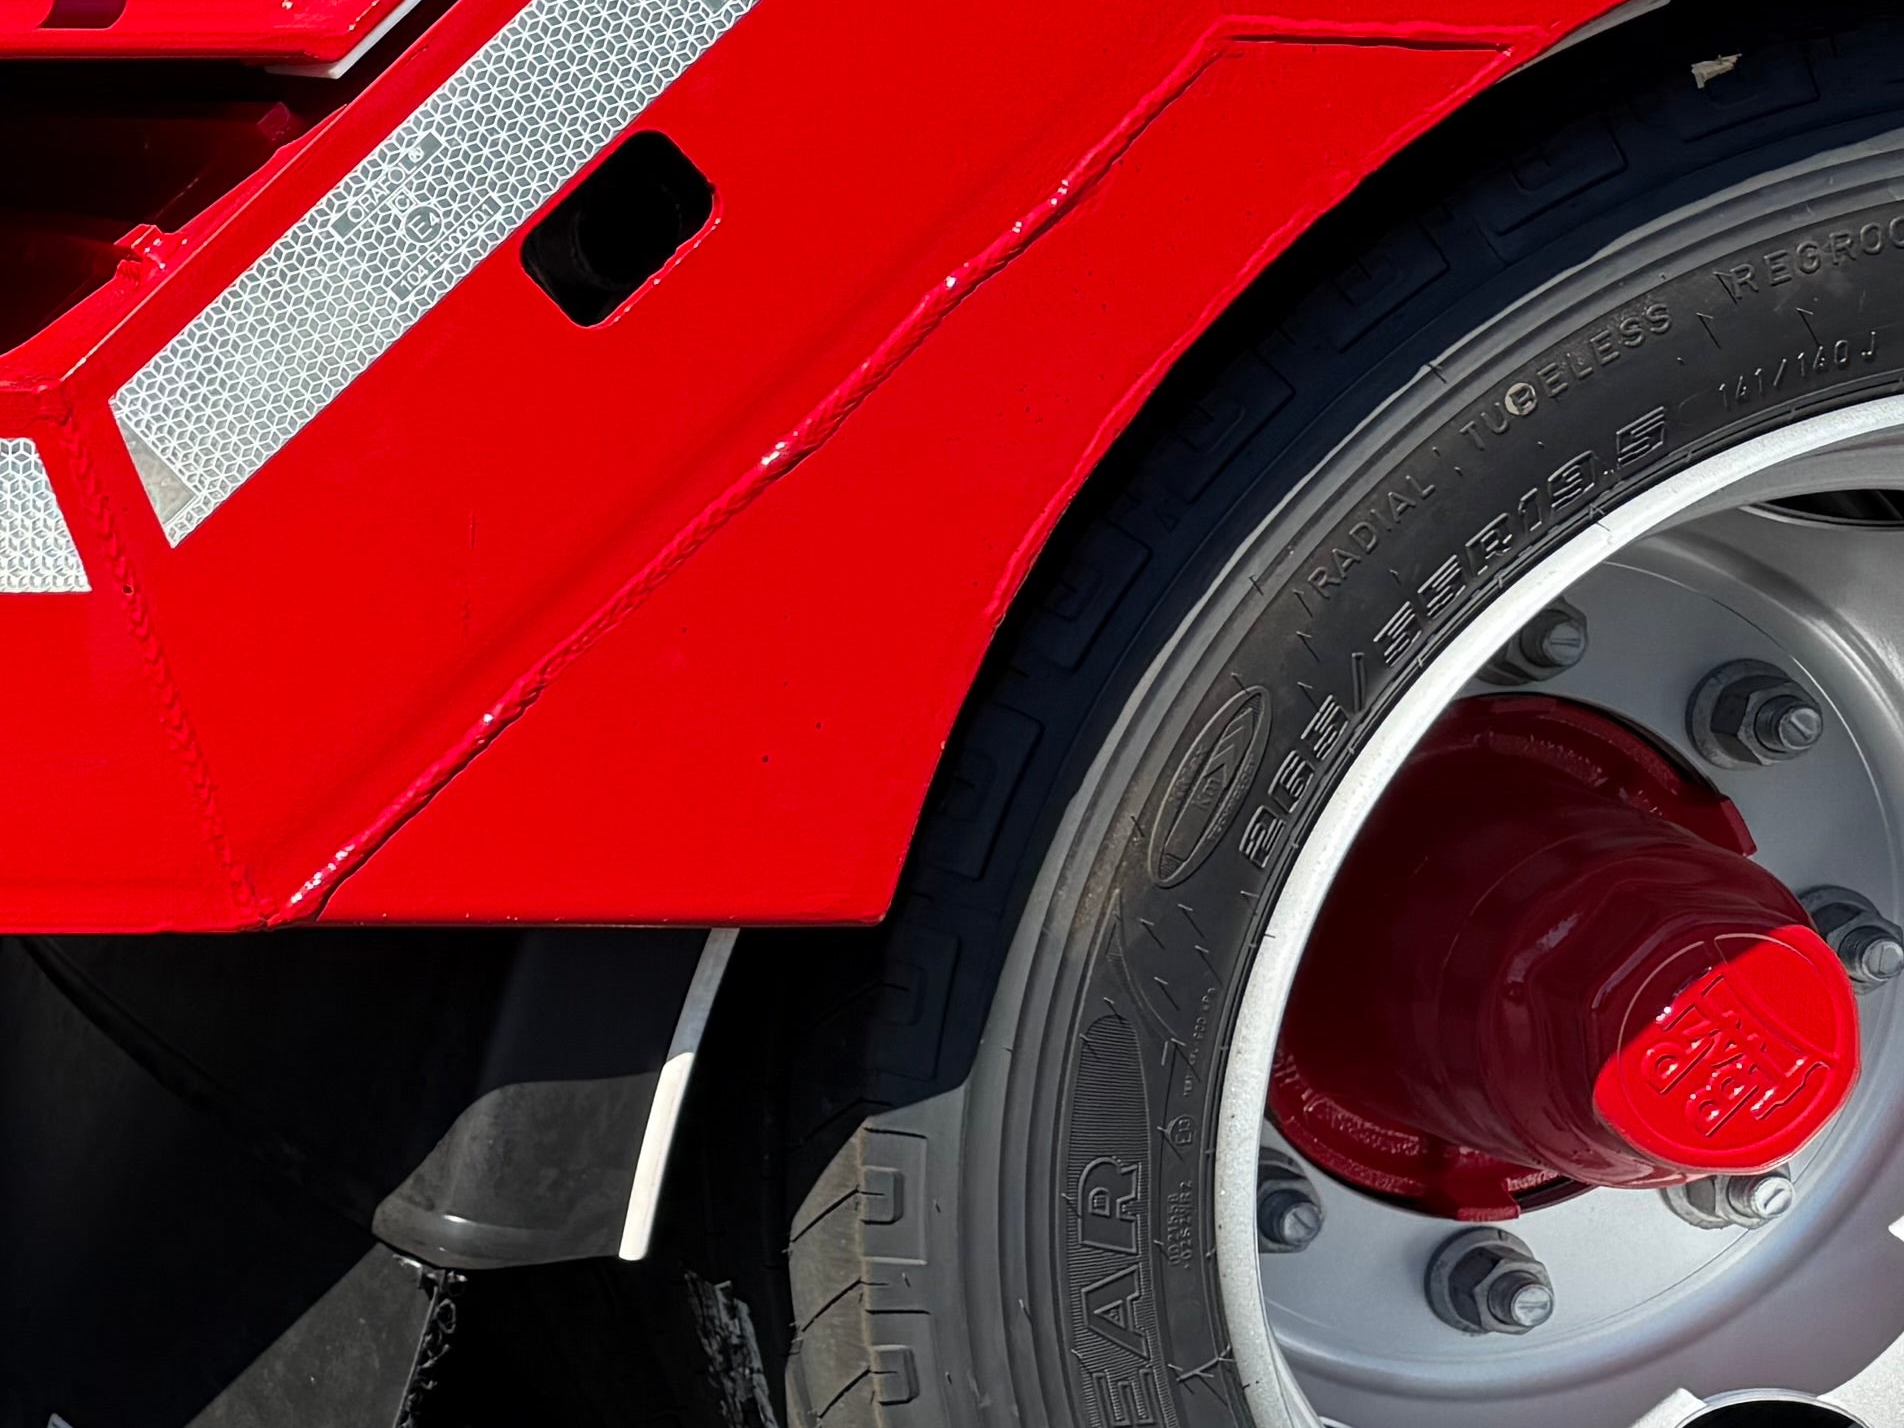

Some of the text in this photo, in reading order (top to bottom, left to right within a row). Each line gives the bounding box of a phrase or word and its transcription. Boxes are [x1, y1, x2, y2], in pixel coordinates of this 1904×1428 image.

[399, 203, 495, 292] 104 R-000001
[1310, 474, 1437, 600] RADIAL
[1457, 303, 1673, 452] TUBELESS
